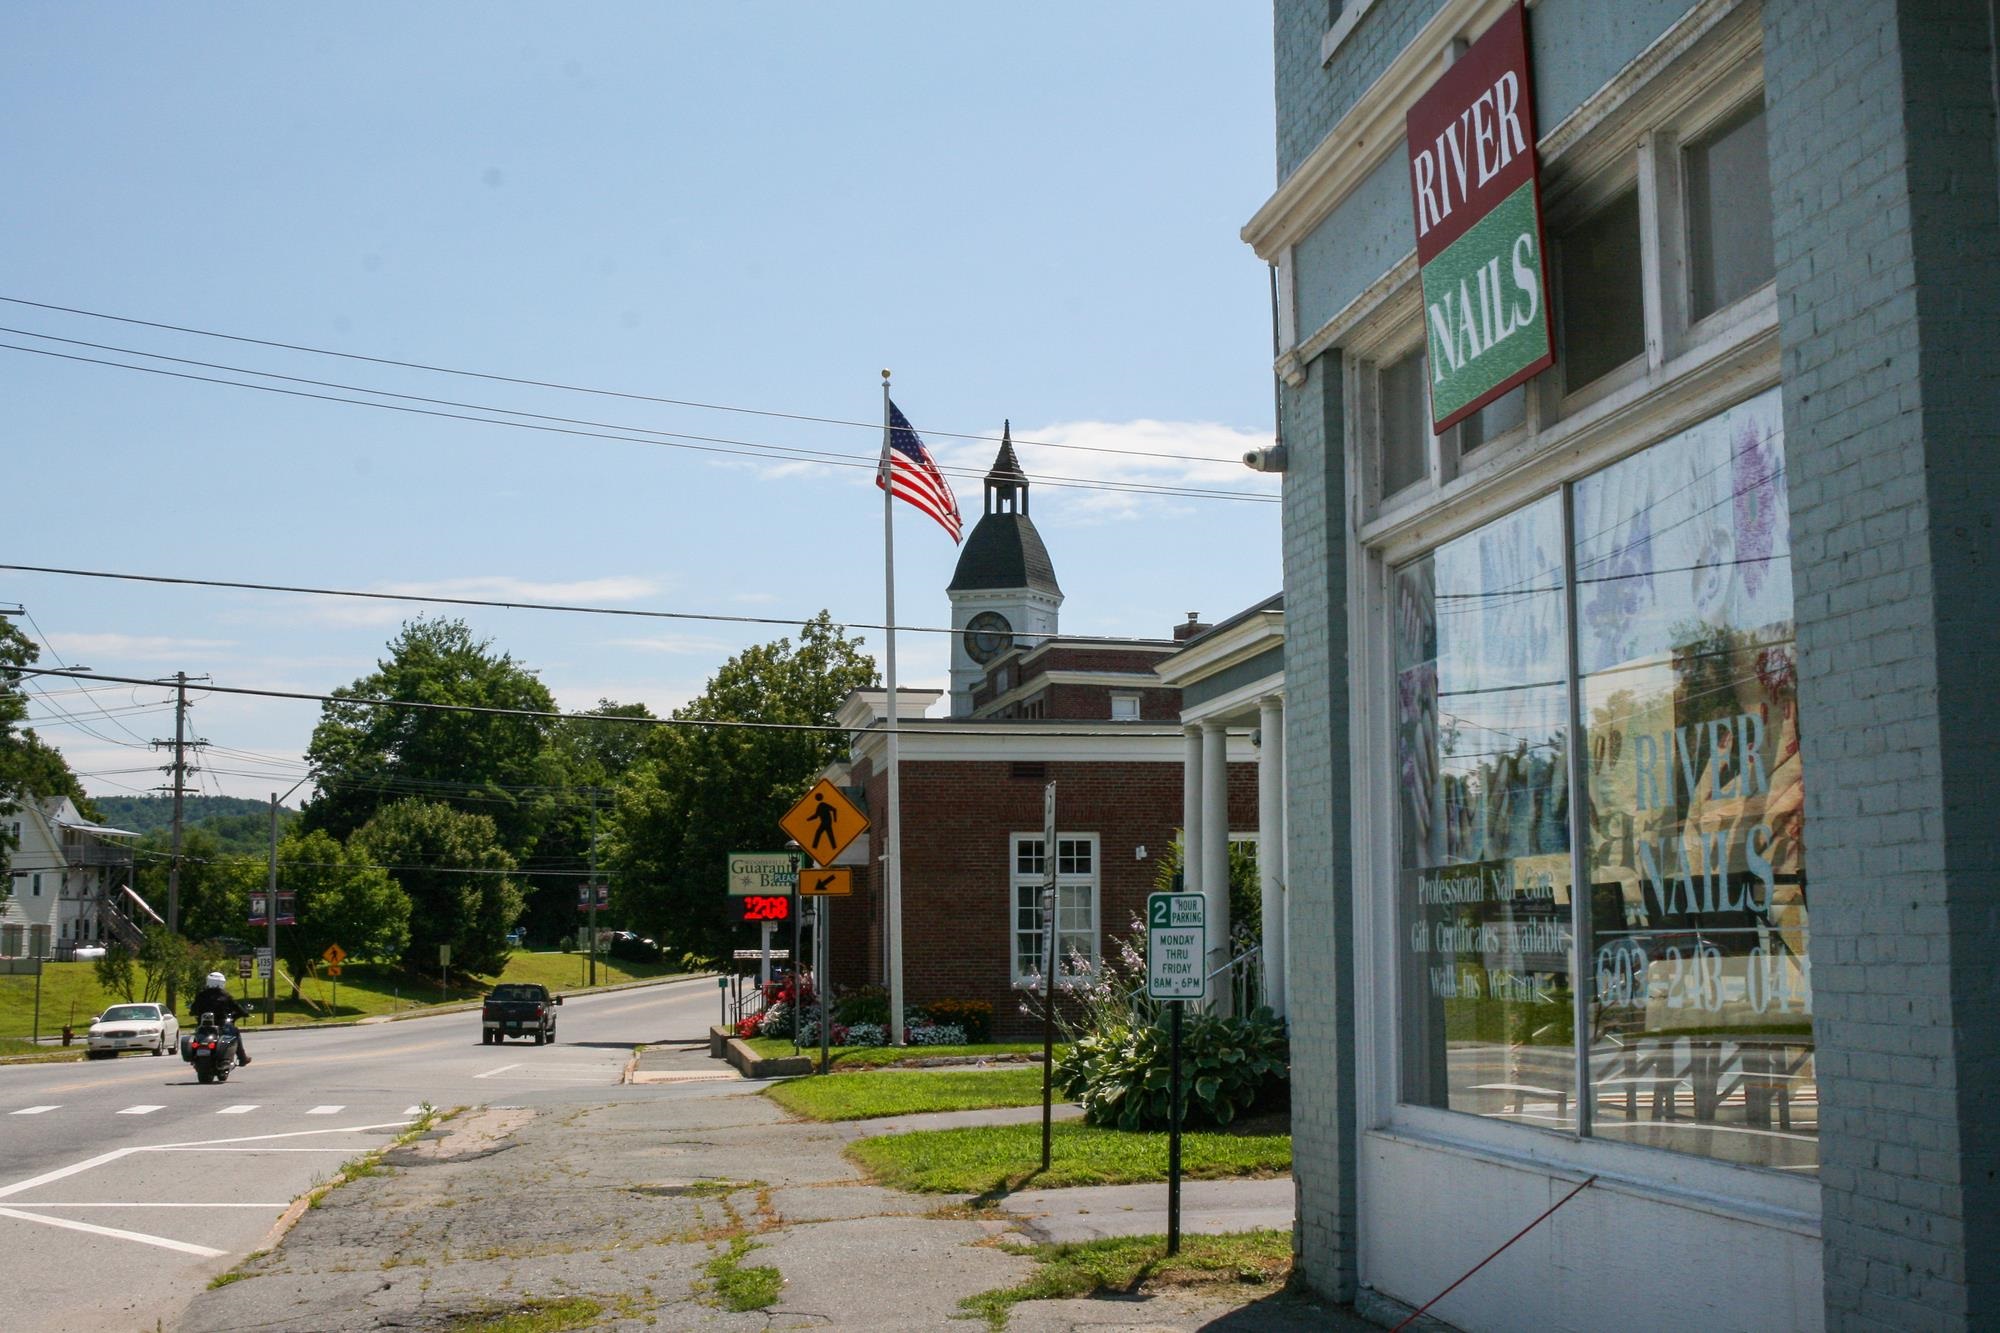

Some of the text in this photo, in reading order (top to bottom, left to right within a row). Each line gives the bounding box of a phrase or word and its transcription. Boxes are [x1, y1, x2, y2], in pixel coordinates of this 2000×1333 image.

[1413, 70, 1526, 238] RIVER
[1429, 233, 1537, 384] NAILS
[1635, 713, 1768, 812] RIVER
[731, 858, 791, 875] Guarant
[1637, 824, 1775, 916] NAILS
[1418, 865, 1554, 904] Professional Nail Care
[1154, 901, 1167, 923] 2
[1179, 900, 1197, 911] HOUR
[1172, 911, 1202, 923] PARKING
[1160, 935, 1194, 945] MONDAY
[1411, 916, 1565, 954] Gift Certificates Available
[1166, 949, 1188, 959] THRU
[1162, 963, 1192, 974] FRIDAY
[1154, 978, 1171, 988] 8AM
[1181, 978, 1200, 988] 6PM
[1597, 946, 1814, 1015] 603-243-044
